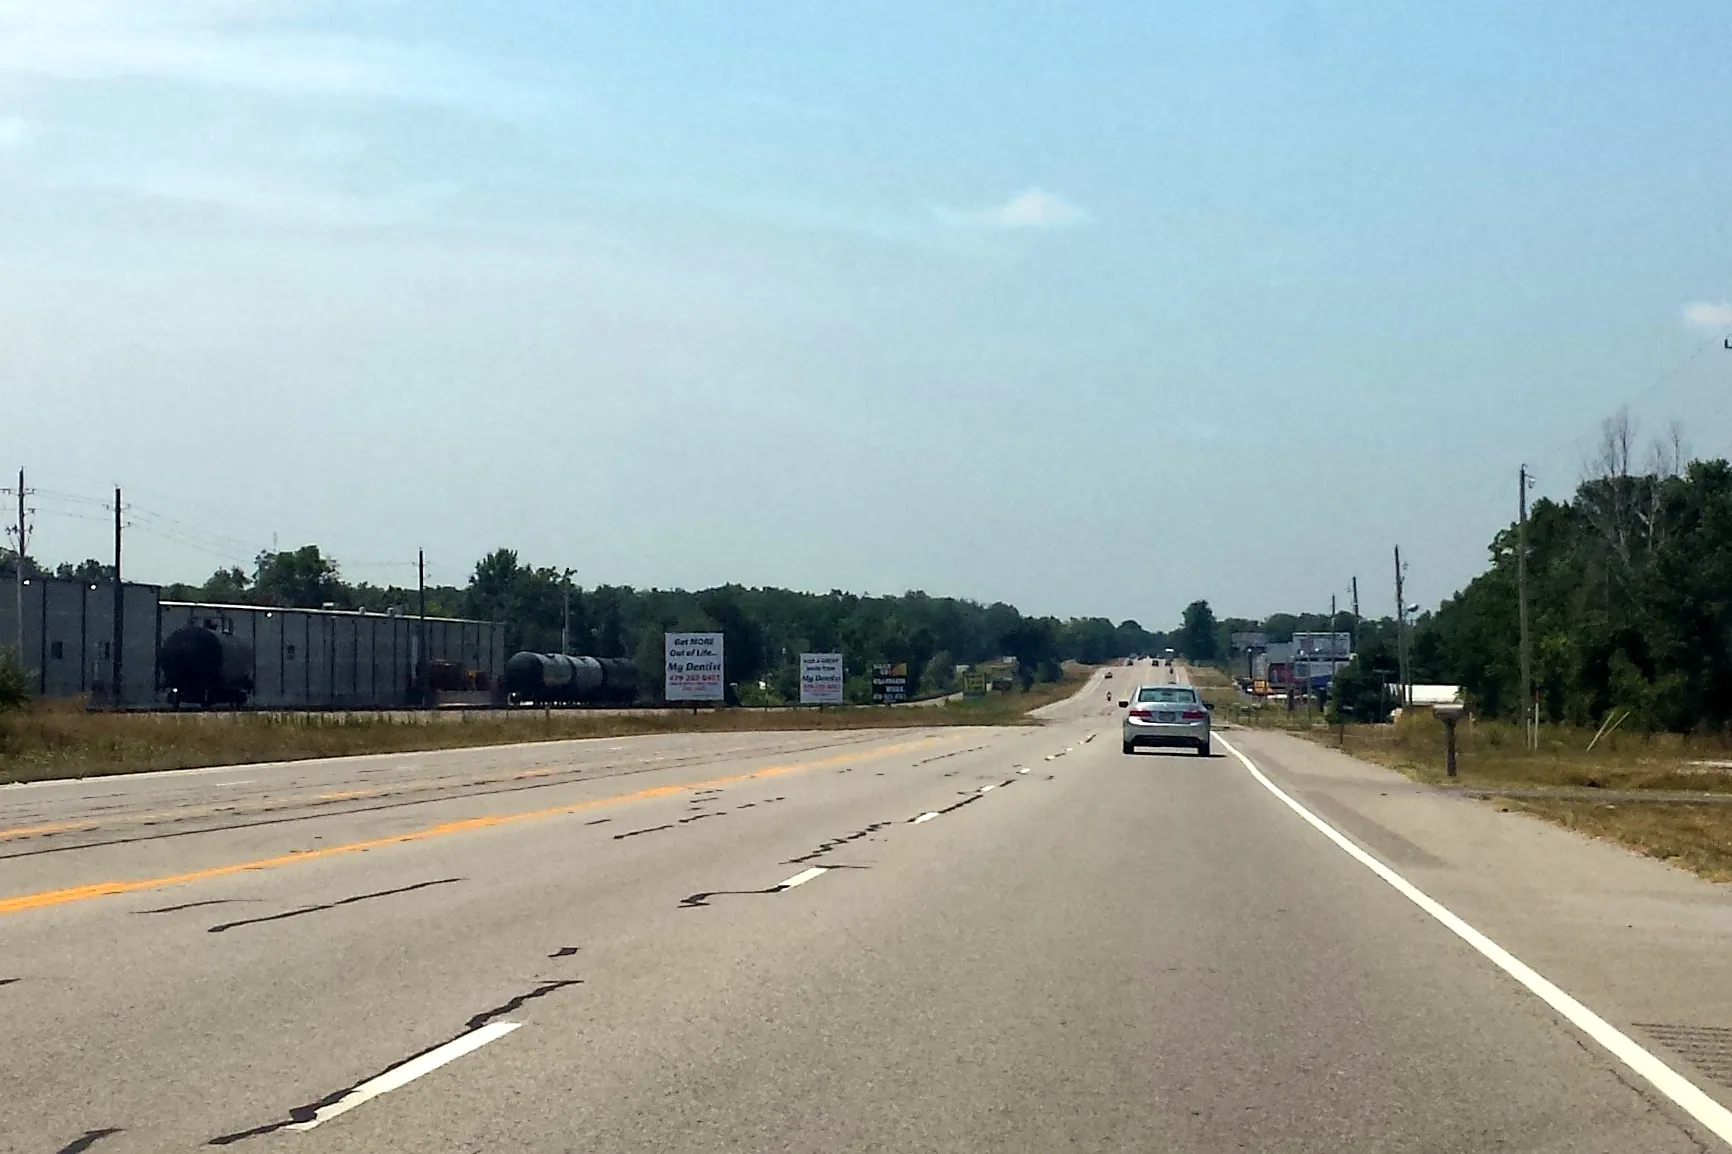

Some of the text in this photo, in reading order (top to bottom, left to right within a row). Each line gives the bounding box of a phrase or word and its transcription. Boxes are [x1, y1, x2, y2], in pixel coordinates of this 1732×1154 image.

[674, 638, 715, 646] Get MORE
[669, 649, 685, 657] Out
[686, 648, 696, 657] of
[668, 662, 721, 673] My Dentist
[802, 675, 814, 683] My
